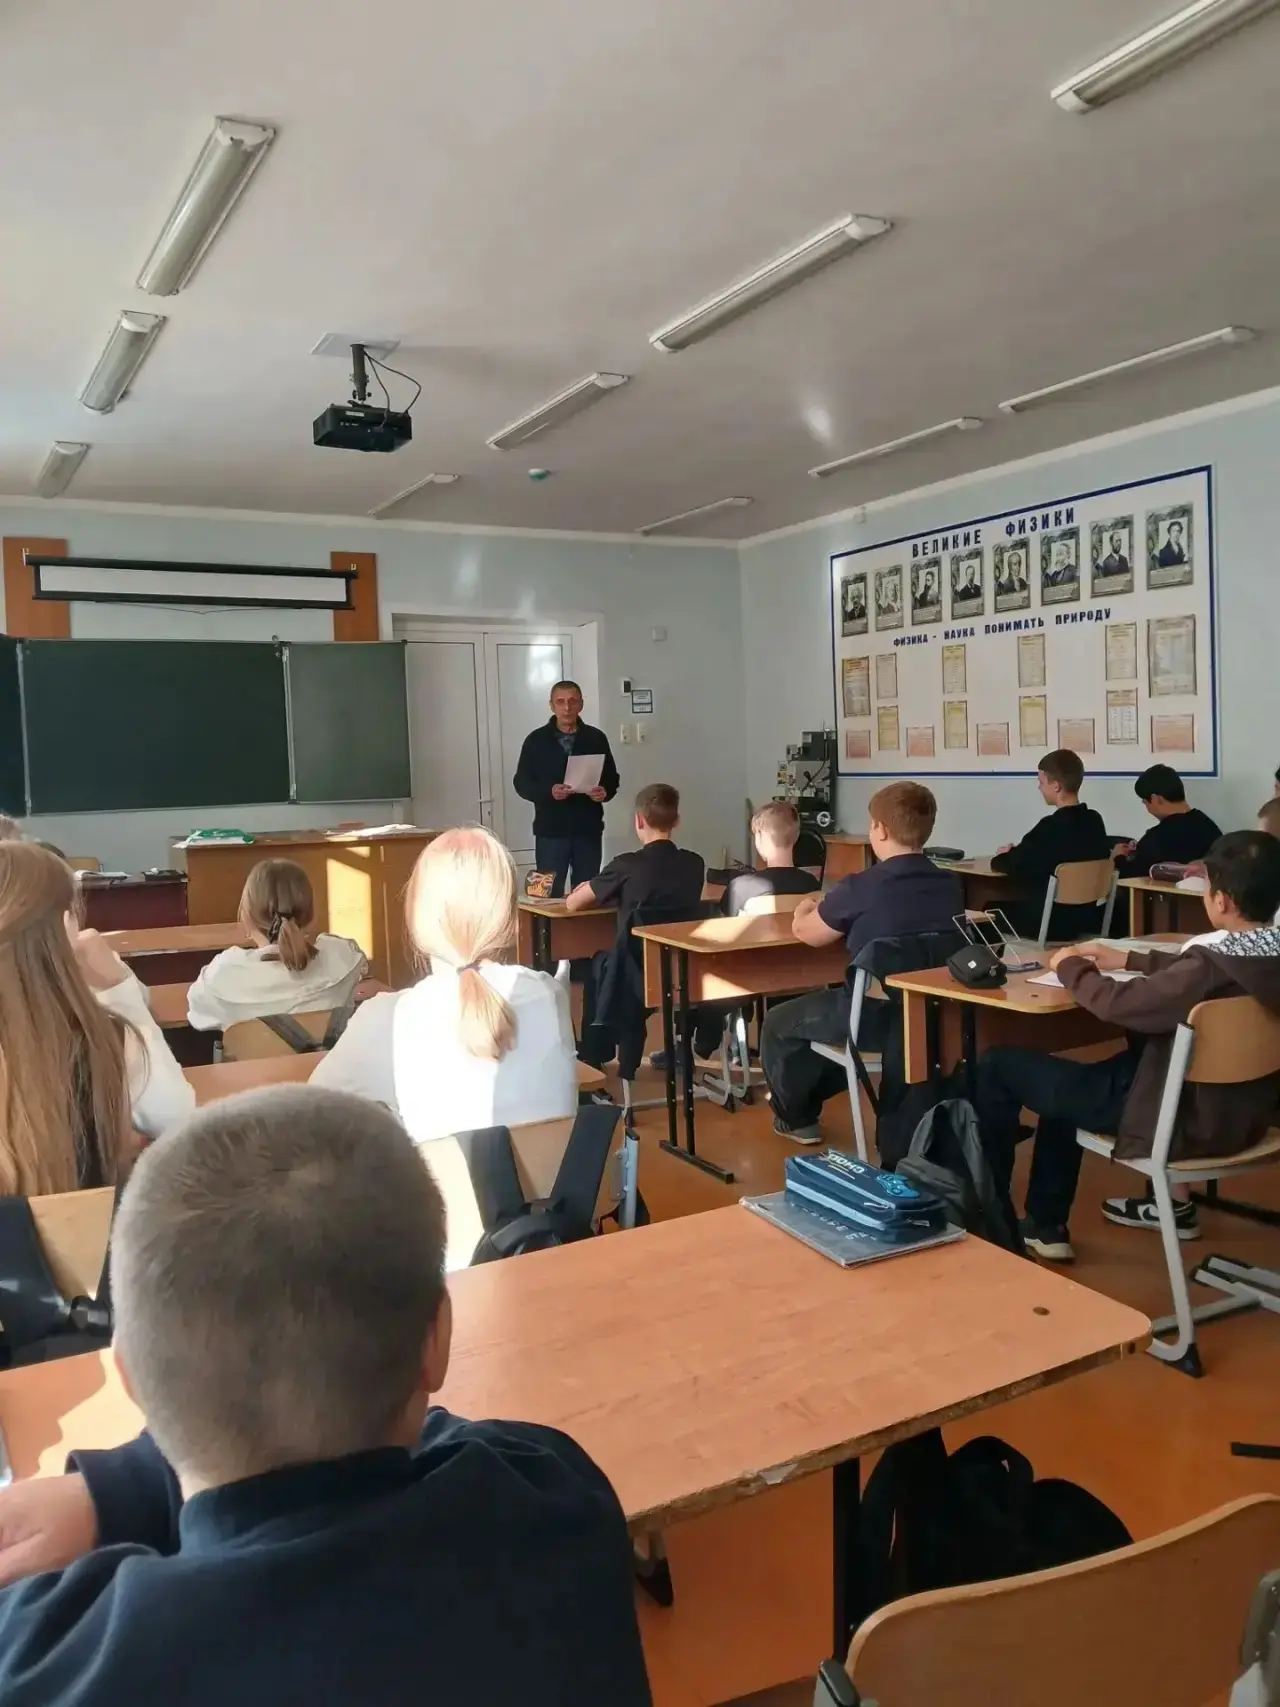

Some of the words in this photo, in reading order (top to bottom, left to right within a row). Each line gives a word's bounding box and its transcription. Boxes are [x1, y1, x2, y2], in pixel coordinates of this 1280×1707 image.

[912, 529, 982, 558] ВЕЛИКИЕ
[1005, 507, 1074, 537] ФИЗИКИ
[893, 634, 929, 647] ФИЗИКА
[944, 627, 975, 640] НАУКА
[984, 617, 1044, 635] ПОНИМАТЬ
[1055, 608, 1111, 625] ПРИРОДУ
